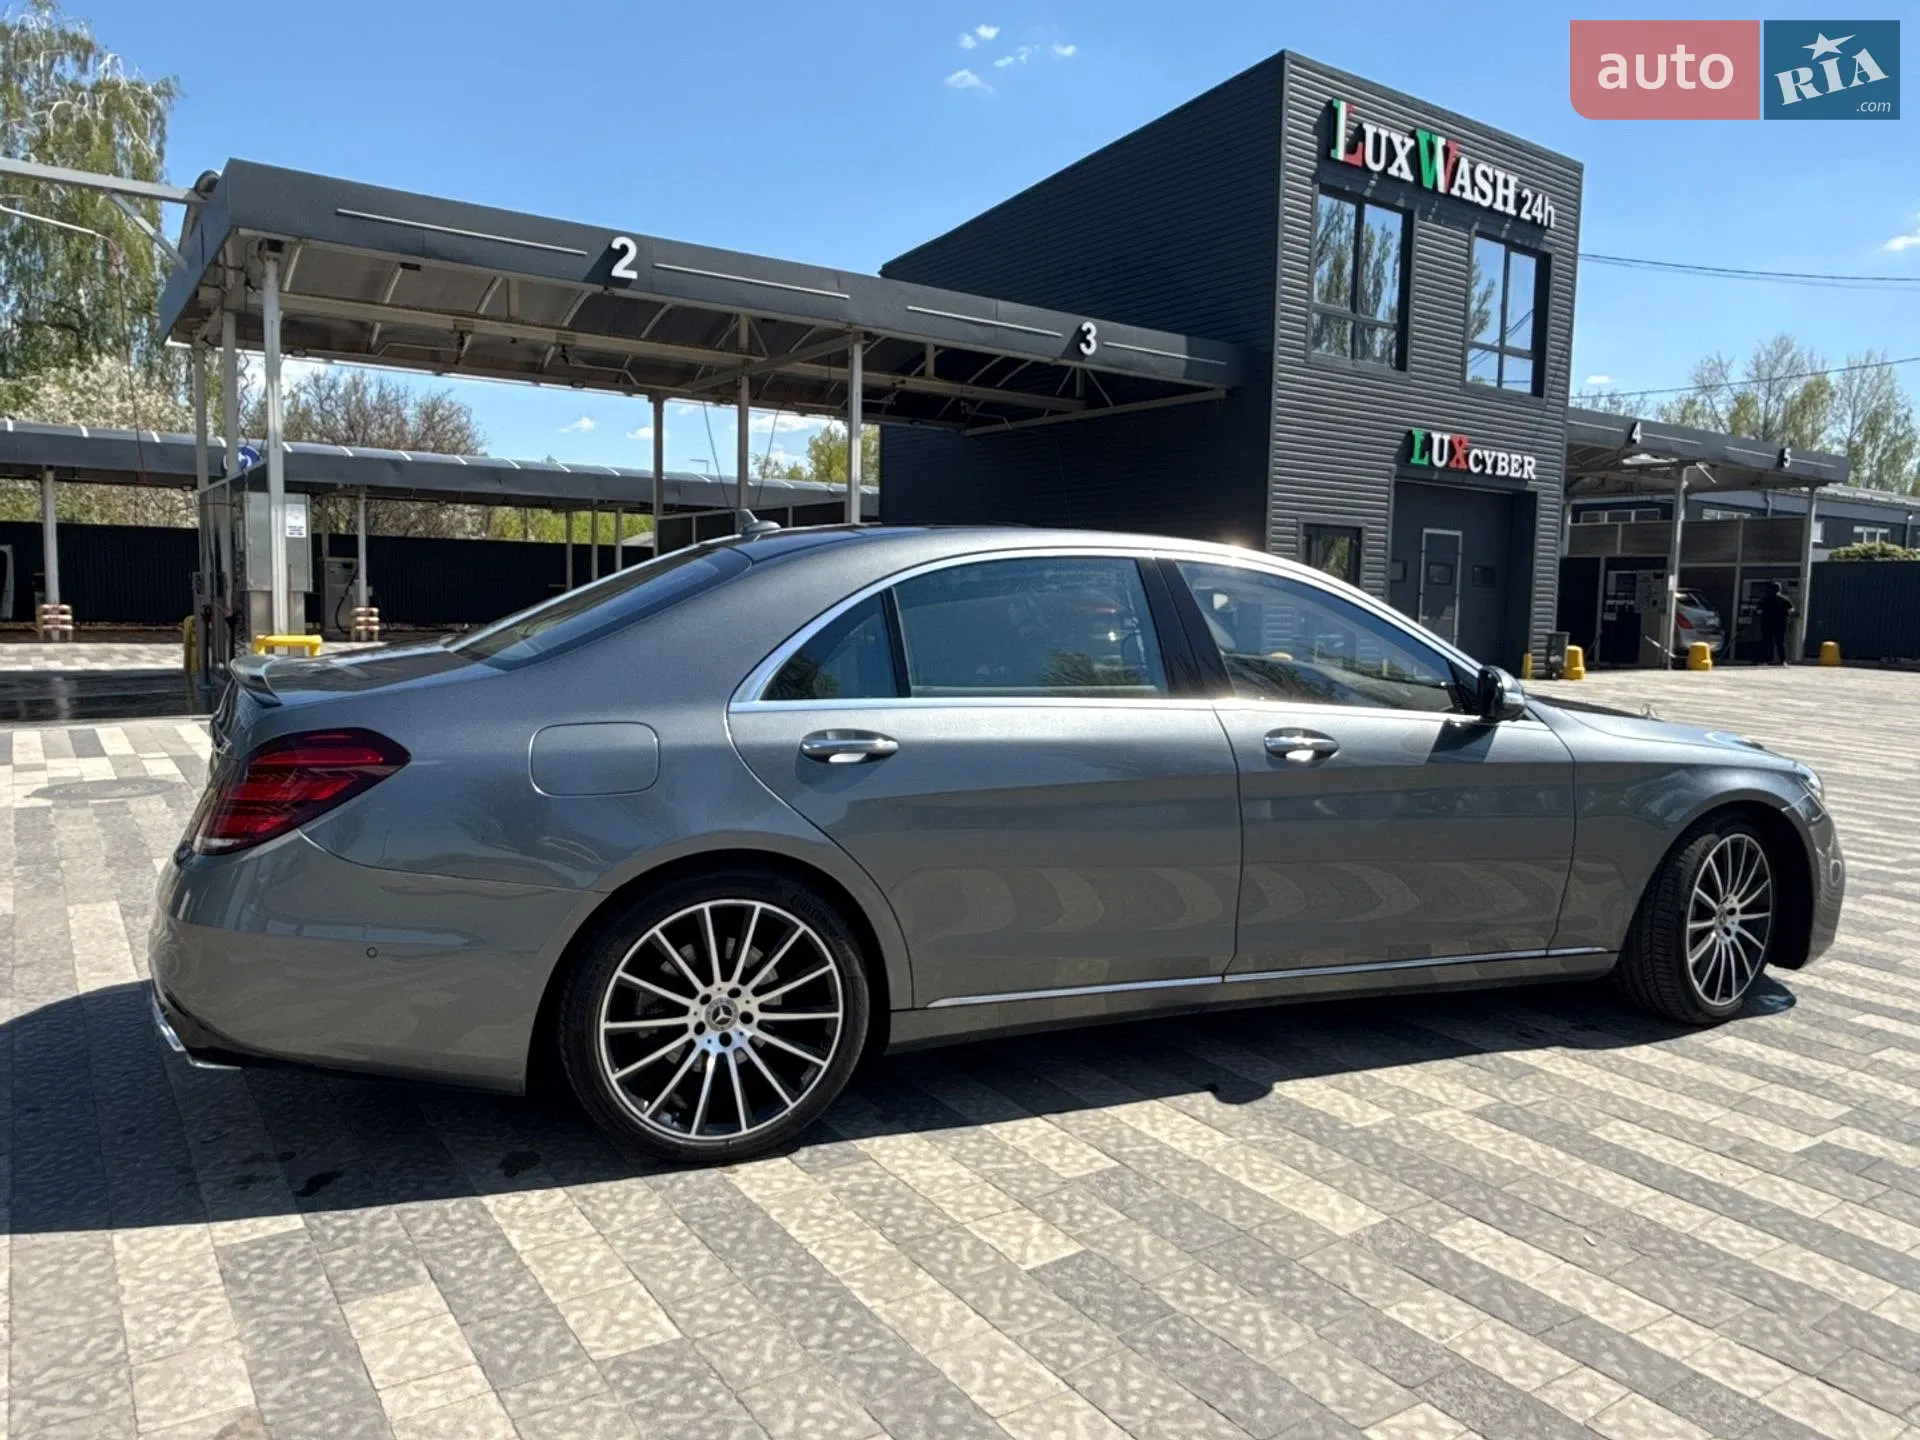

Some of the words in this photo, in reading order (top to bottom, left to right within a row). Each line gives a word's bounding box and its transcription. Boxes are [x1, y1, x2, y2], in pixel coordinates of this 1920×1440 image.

[1520, 187, 1556, 229] 24h
[611, 236, 638, 280] 2
[1079, 321, 1097, 355] 3
[1632, 421, 1643, 444] 4
[1782, 447, 1791, 468] 5
